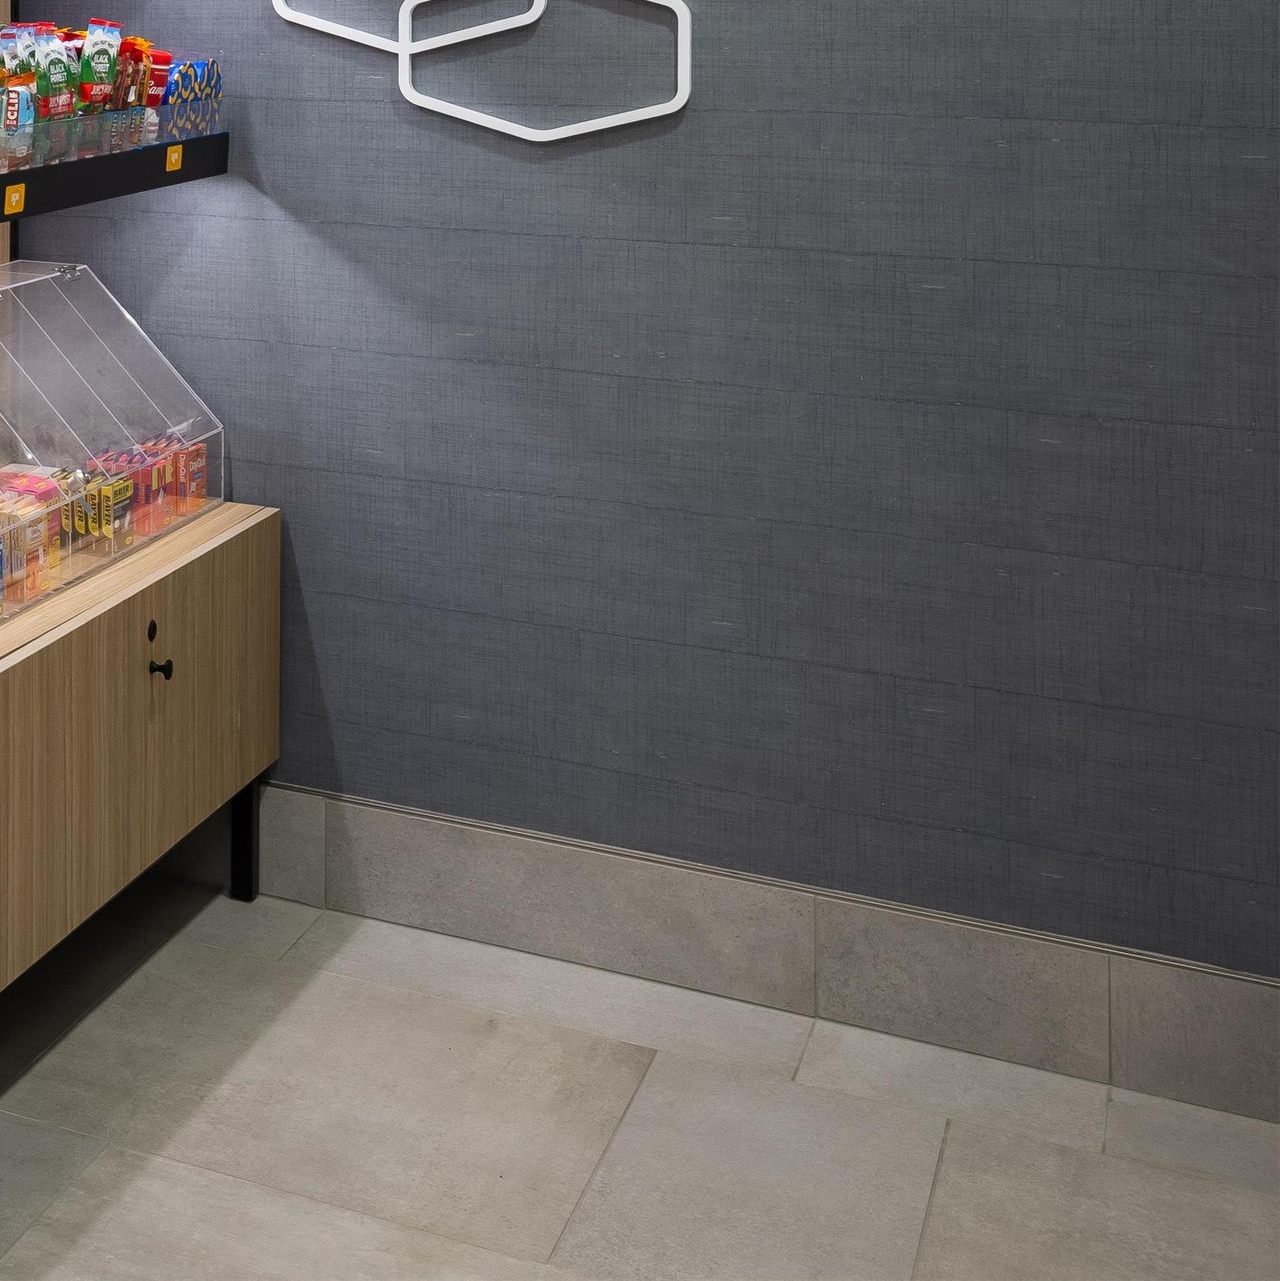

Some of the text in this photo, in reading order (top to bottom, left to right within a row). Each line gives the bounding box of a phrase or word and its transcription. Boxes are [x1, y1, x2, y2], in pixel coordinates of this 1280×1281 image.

[49, 63, 65, 73] BLACK
[93, 54, 109, 63] BLACK
[7, 90, 19, 119] CLIF
[179, 454, 187, 482] DayQuil
[90, 494, 99, 527] BAYER
[103, 495, 111, 526] BAYER
